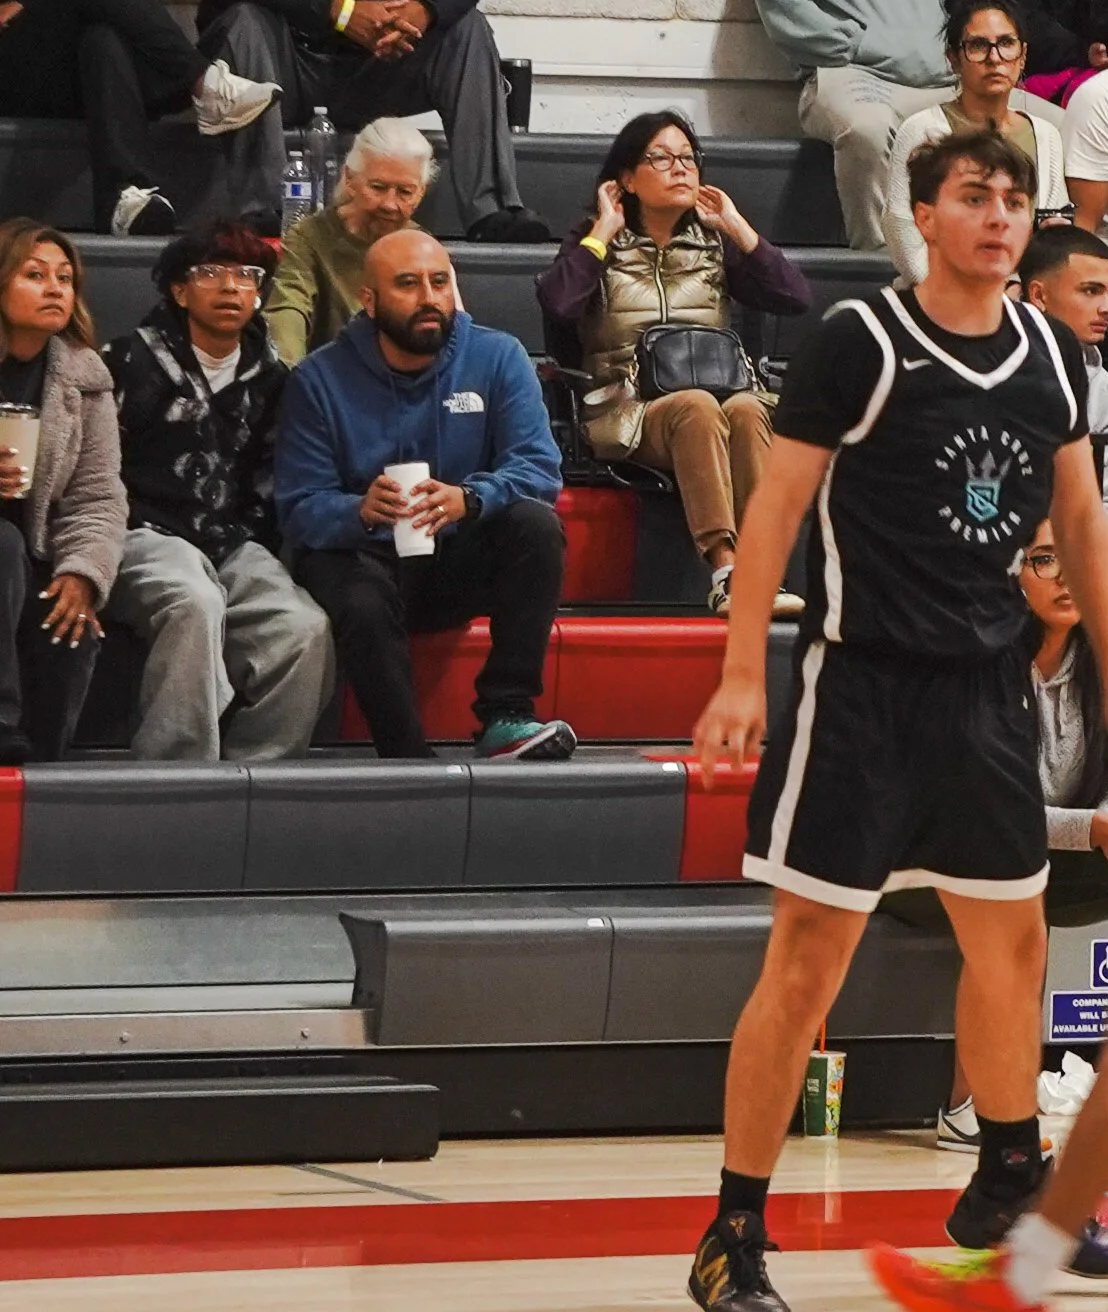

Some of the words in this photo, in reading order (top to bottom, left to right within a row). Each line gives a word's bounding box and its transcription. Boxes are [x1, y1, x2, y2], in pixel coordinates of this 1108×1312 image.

[935, 425, 989, 471] SANTA
[1000, 430, 1033, 477] CRUZ
[938, 505, 1022, 544] PREMIER
[1079, 1011, 1100, 1020] WILL
[1053, 1024, 1098, 1033] AVAILABLE
